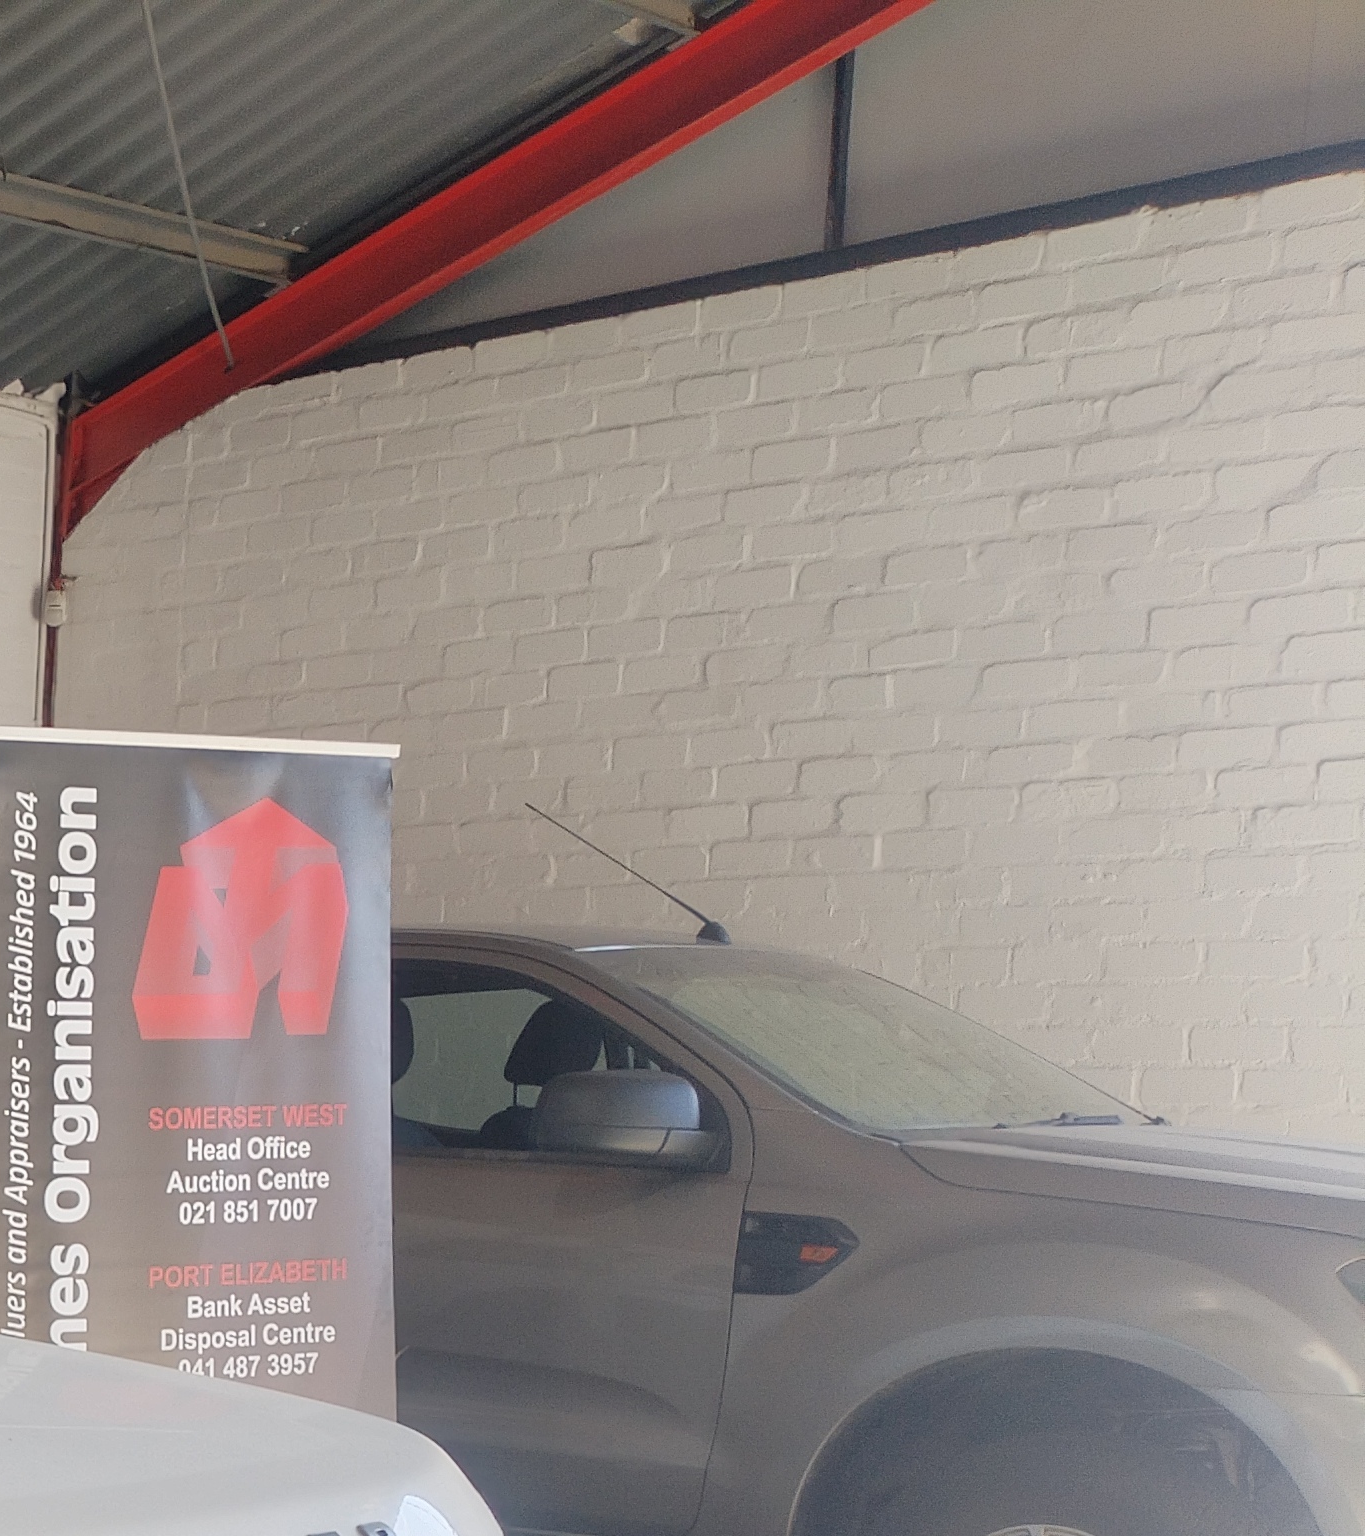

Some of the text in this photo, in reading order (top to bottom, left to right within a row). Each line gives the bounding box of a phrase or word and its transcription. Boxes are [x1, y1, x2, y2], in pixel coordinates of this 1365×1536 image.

[13, 791, 38, 862] 1964
[7, 869, 36, 1032] Established
[44, 786, 100, 1223] Organisation
[4, 1056, 33, 1205] Appraisers
[148, 1103, 348, 1131] SOMERSET WEST
[186, 1135, 311, 1161] Head Office
[166, 1167, 330, 1194] Auction Centre
[178, 1197, 318, 1225] 021 851 7007
[2, 1209, 28, 1264] and
[148, 1257, 348, 1289] PORT ELIZABETH
[0, 1271, 26, 1338] luers
[187, 1291, 311, 1319] Bank Asset
[161, 1322, 336, 1355] Disposal Centre
[178, 1352, 319, 1378] 041 487 3957
